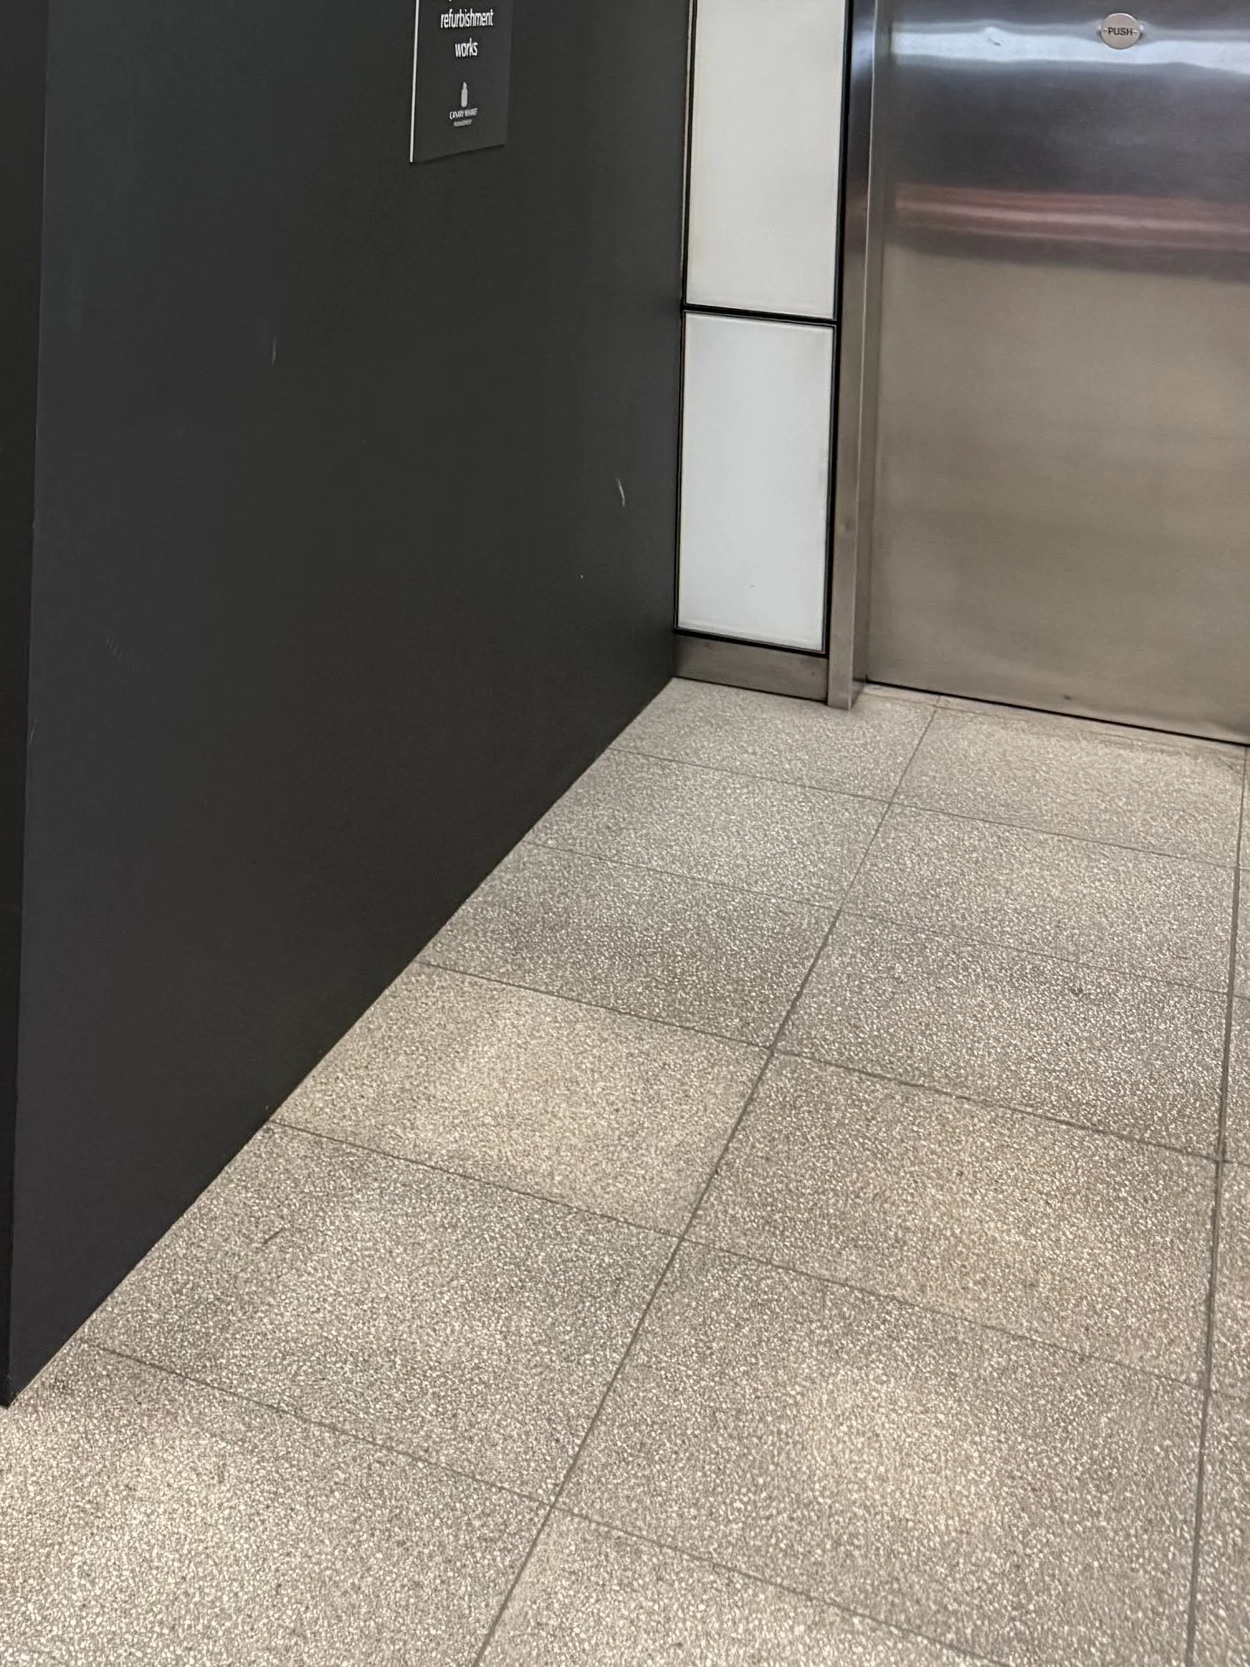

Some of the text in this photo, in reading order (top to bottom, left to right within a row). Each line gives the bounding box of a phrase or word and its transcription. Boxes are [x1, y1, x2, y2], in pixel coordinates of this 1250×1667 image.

[440, 7, 494, 29] refurbishment
[1107, 27, 1133, 36] PUSH
[455, 38, 478, 58] works
